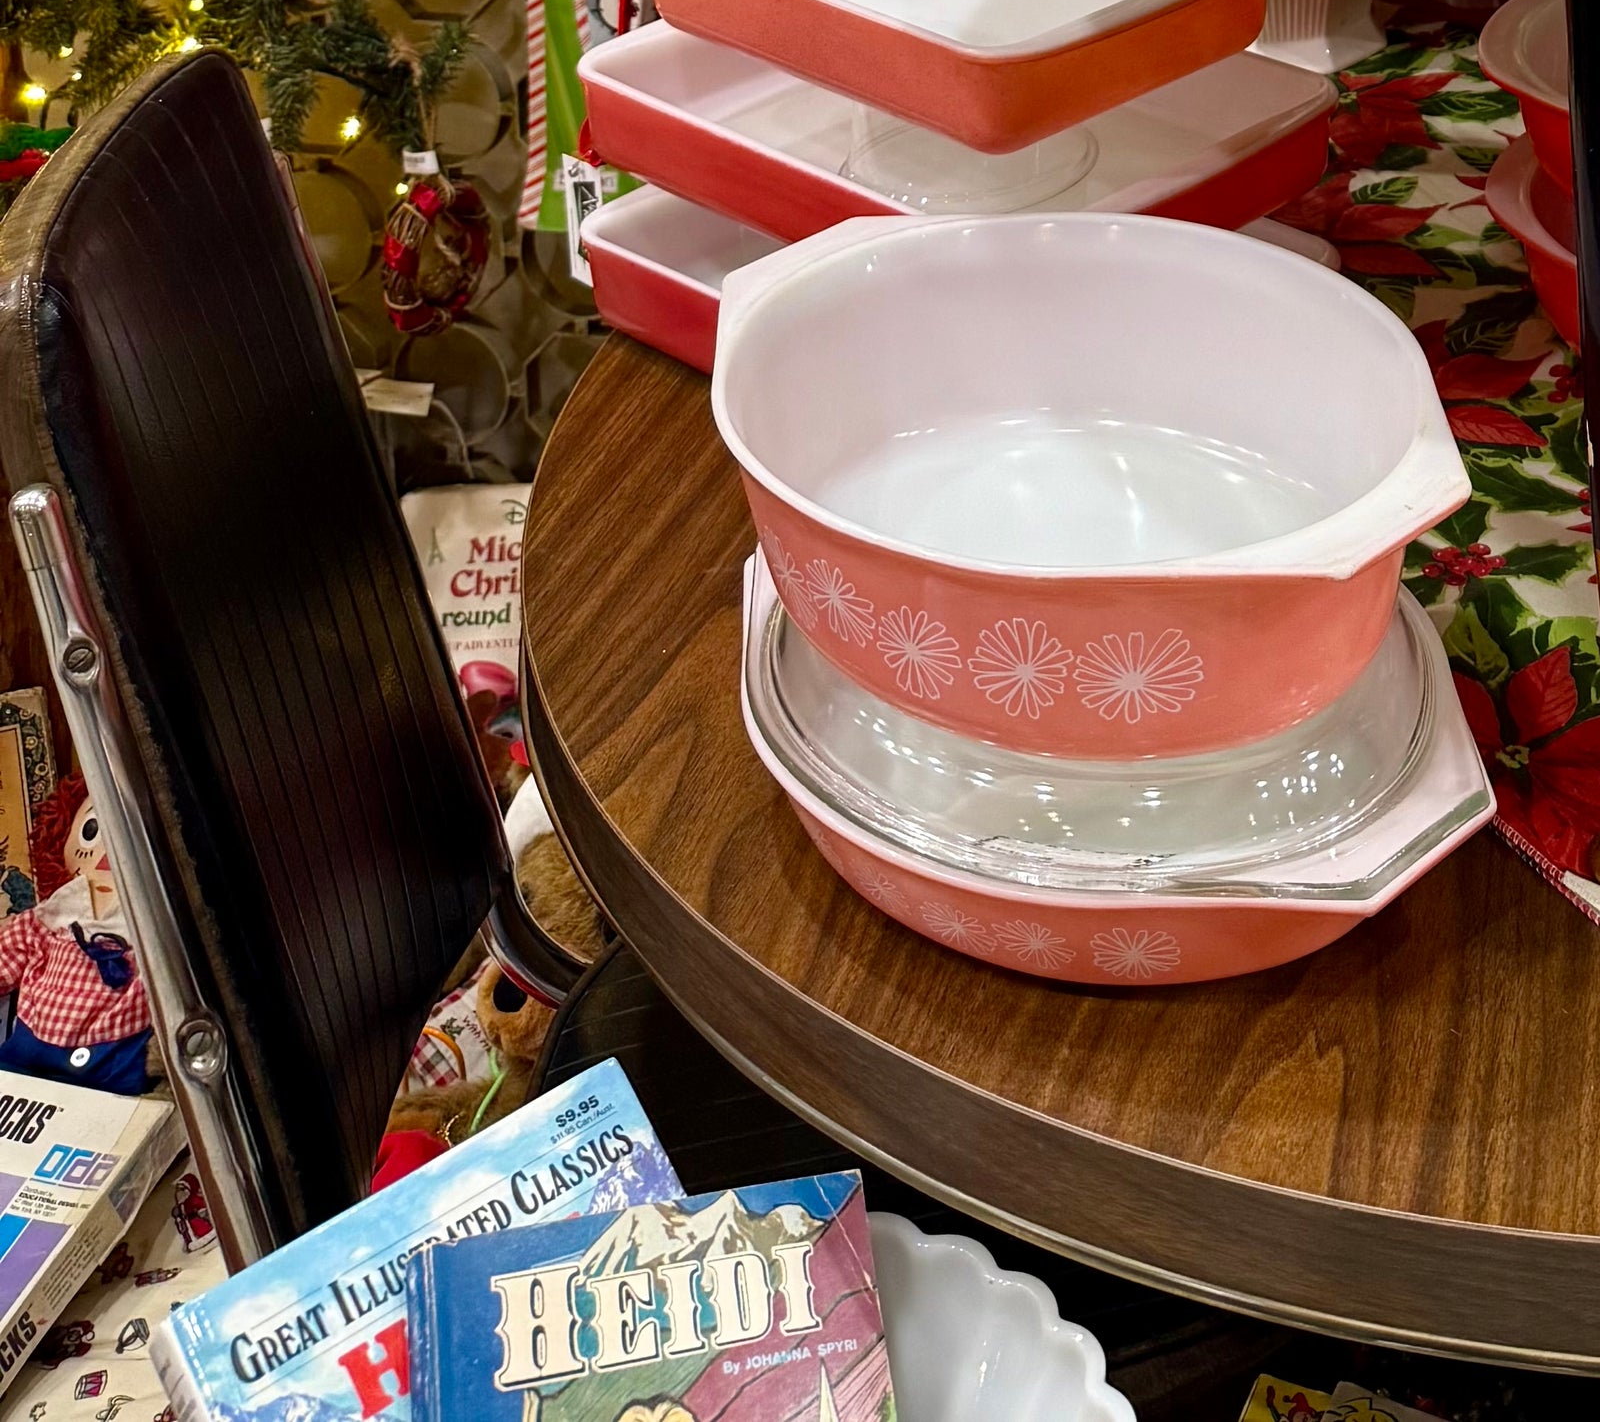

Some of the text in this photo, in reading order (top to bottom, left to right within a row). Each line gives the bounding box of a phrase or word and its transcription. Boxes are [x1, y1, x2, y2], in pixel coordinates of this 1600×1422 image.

[555, 1095, 599, 1127] $9.95
[231, 1302, 330, 1383] GREAT
[511, 1124, 634, 1215] CLASSICS
[491, 1243, 823, 1392] HEIDI
[723, 1339, 858, 1376] By JOHANNA SPYRI
